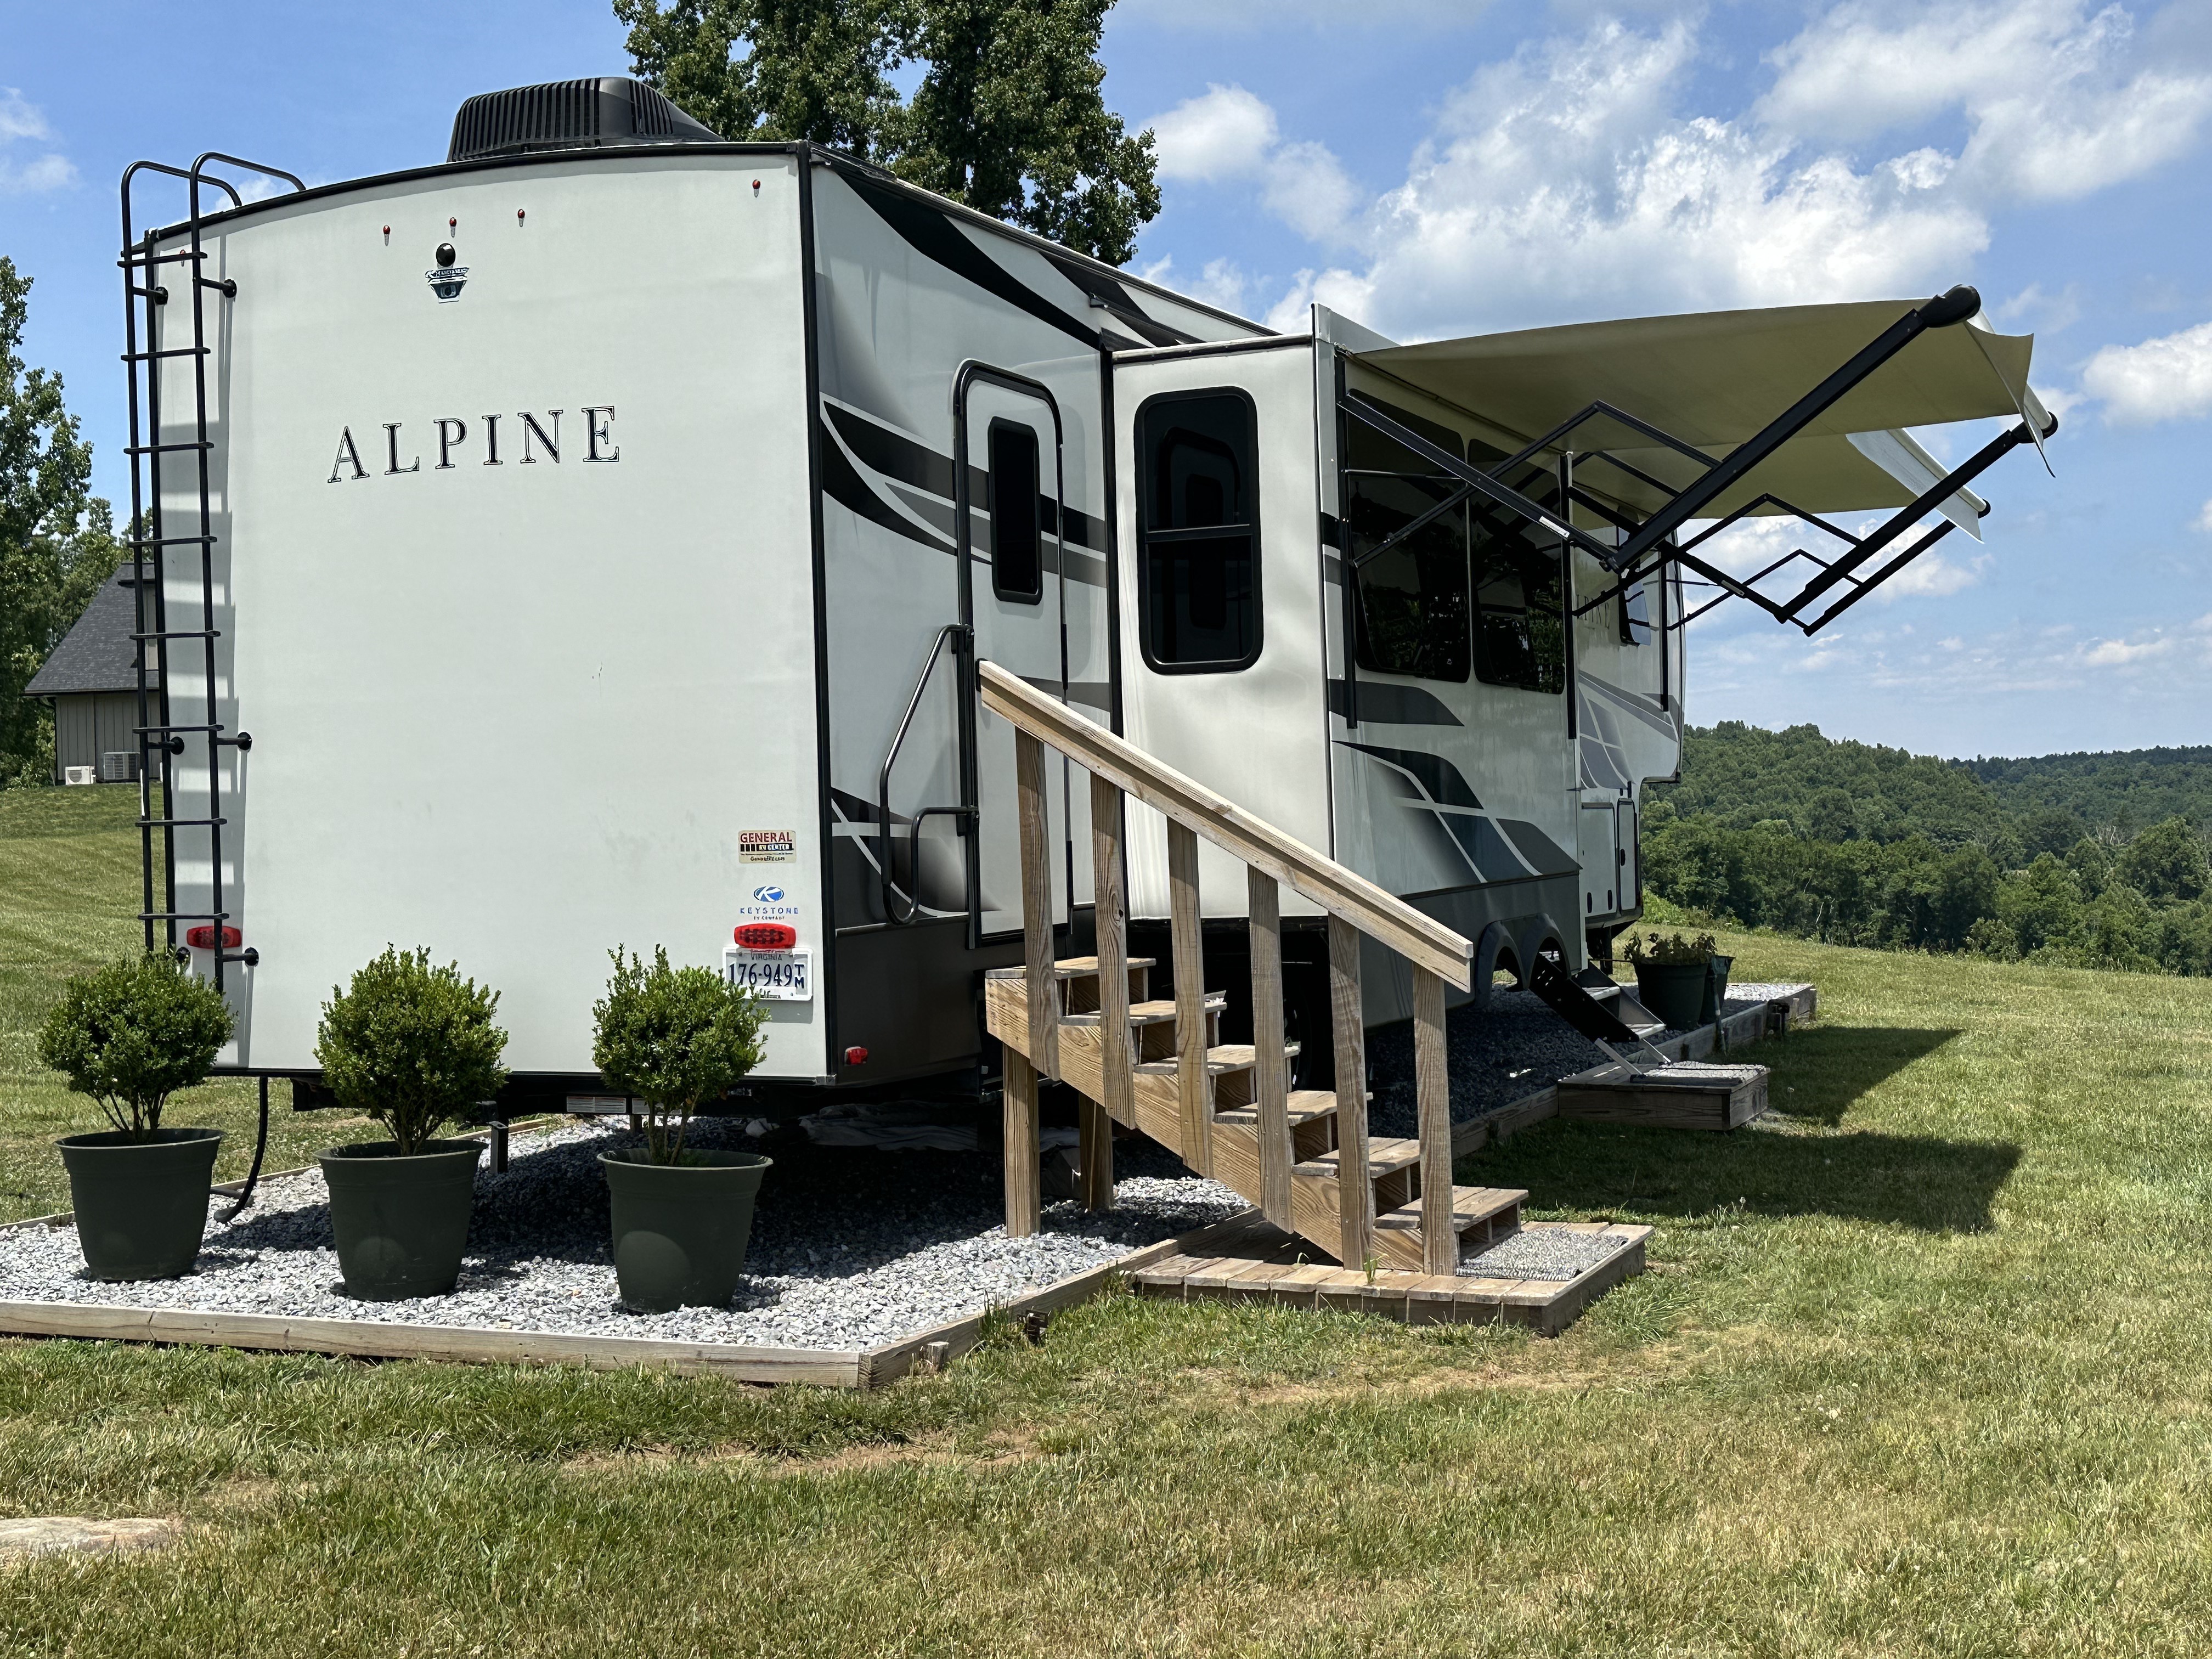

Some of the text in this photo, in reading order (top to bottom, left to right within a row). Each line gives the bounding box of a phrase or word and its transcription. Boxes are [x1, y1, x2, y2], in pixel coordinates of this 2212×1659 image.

[328, 405, 619, 483] ALPINE
[740, 832, 792, 843] GENERAL
[729, 963, 793, 986] 176-949
